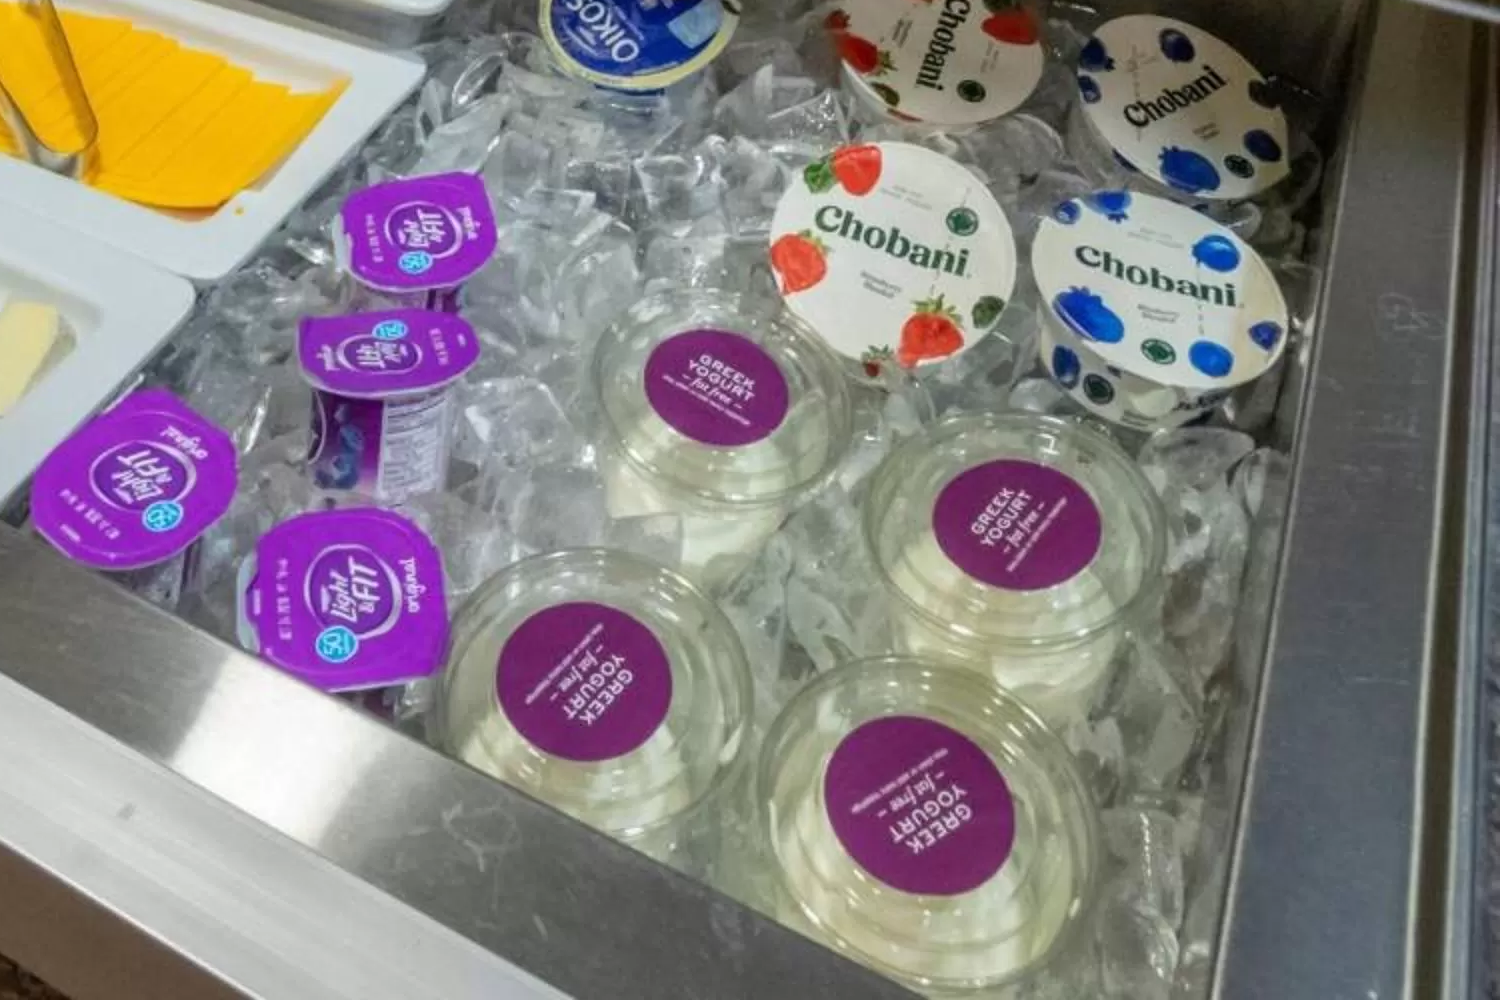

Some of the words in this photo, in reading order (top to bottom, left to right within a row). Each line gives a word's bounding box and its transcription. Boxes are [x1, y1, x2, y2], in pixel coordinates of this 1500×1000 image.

[1123, 64, 1228, 128] Chobani
[814, 204, 972, 279] Chobani
[1074, 244, 1238, 308] Chobani
[688, 359, 756, 401] YOGURT
[699, 353, 756, 390] GREEK
[971, 487, 1016, 536] GREEK
[980, 489, 1034, 548] YOGURT
[397, 556, 428, 614] original
[562, 653, 626, 720] YOGURT
[579, 668, 634, 726] GREEK
[888, 783, 969, 844] YOGURT
[905, 803, 973, 854] GREEK
